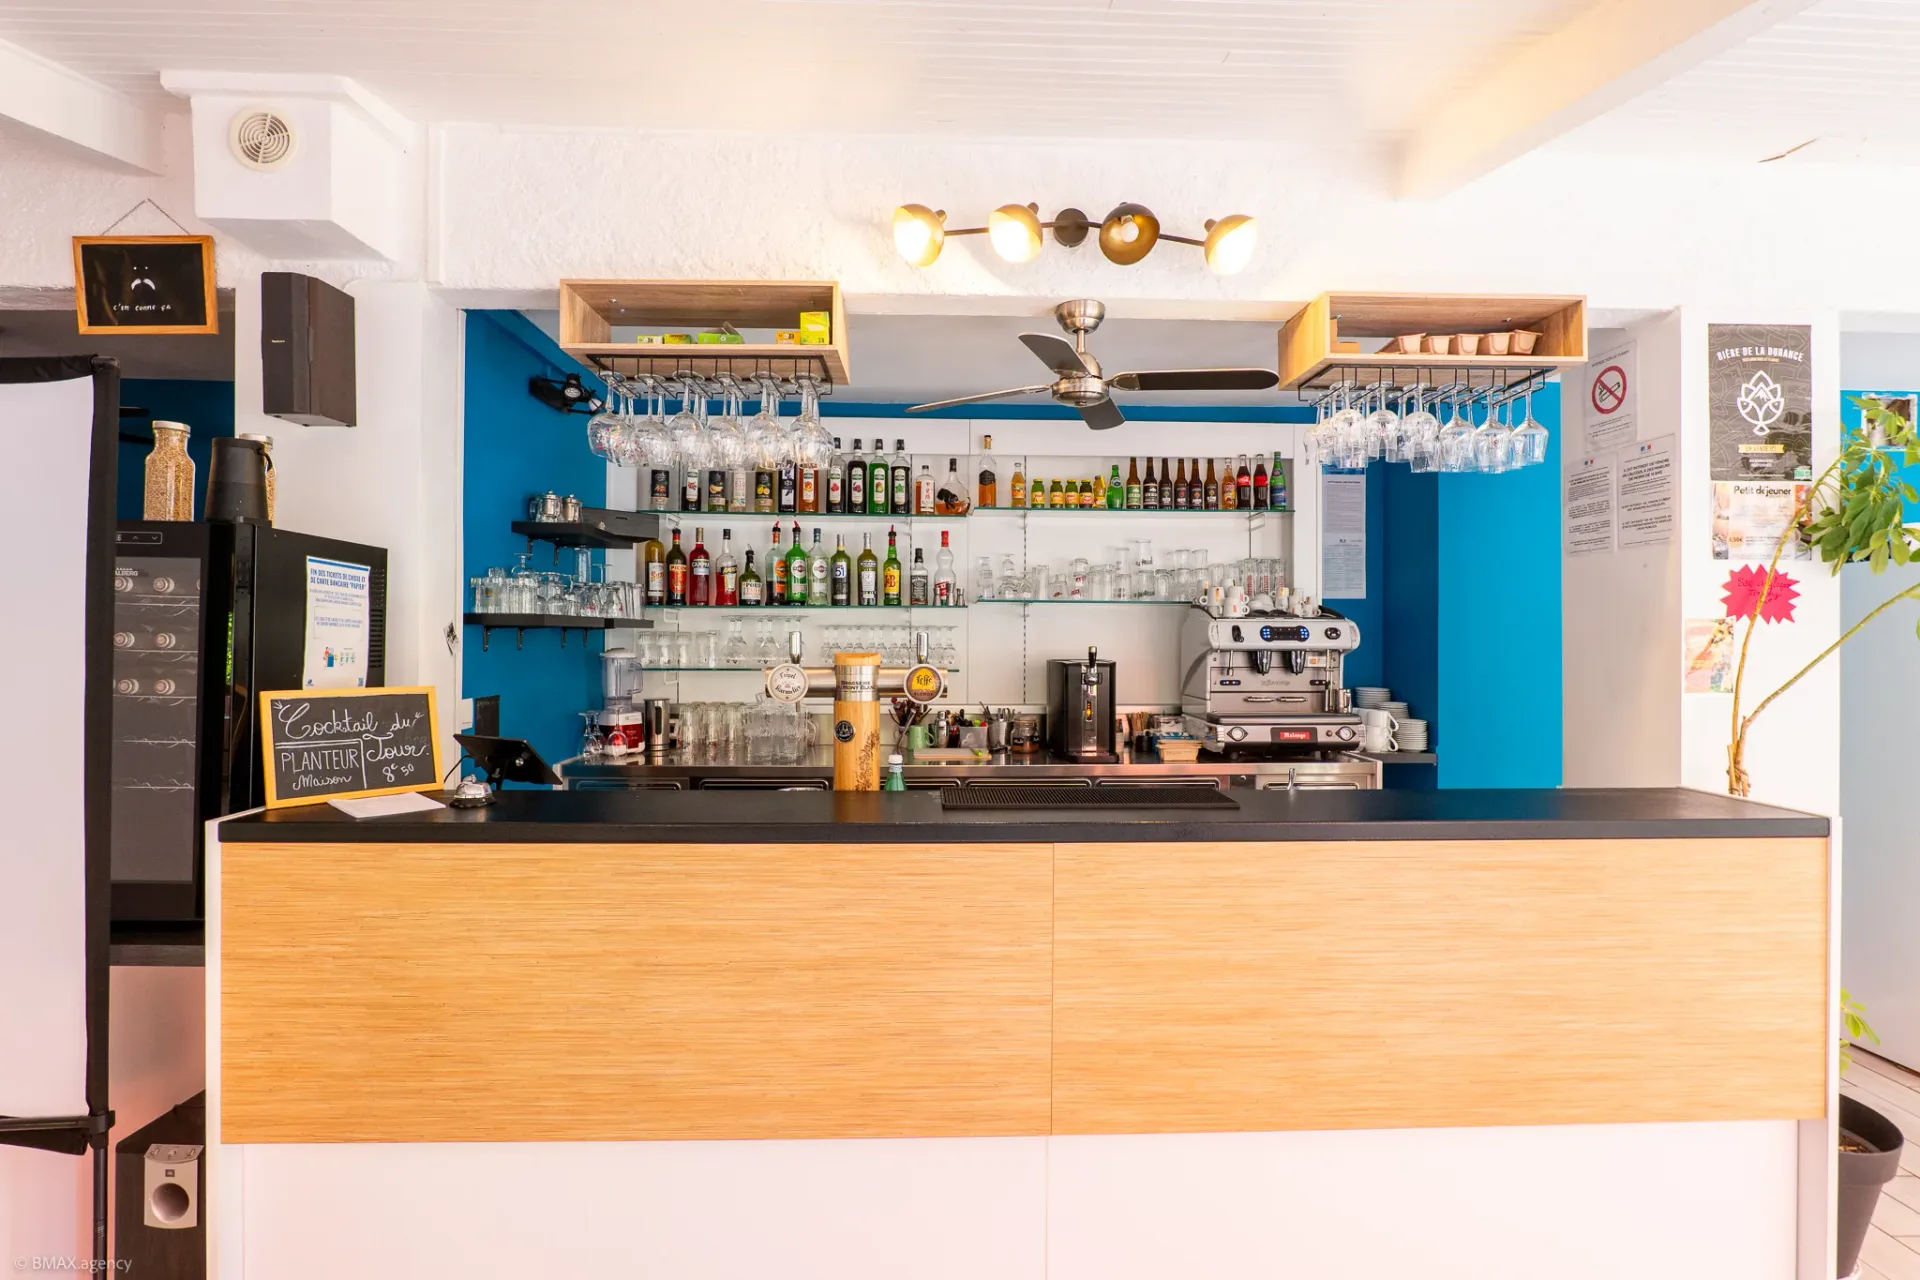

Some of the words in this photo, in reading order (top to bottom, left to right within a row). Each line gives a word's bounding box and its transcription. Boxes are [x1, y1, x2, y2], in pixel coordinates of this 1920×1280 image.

[1742, 346, 1753, 356] DE
[1755, 346, 1767, 356] LA
[1767, 346, 1804, 362] DURANCE
[1733, 485, 1754, 496] Petit
[834, 567, 845, 577] 51
[278, 702, 379, 740] Cocktail
[389, 712, 417, 732] du
[281, 748, 360, 774] PLANTEUR
[292, 774, 352, 791] Maison
